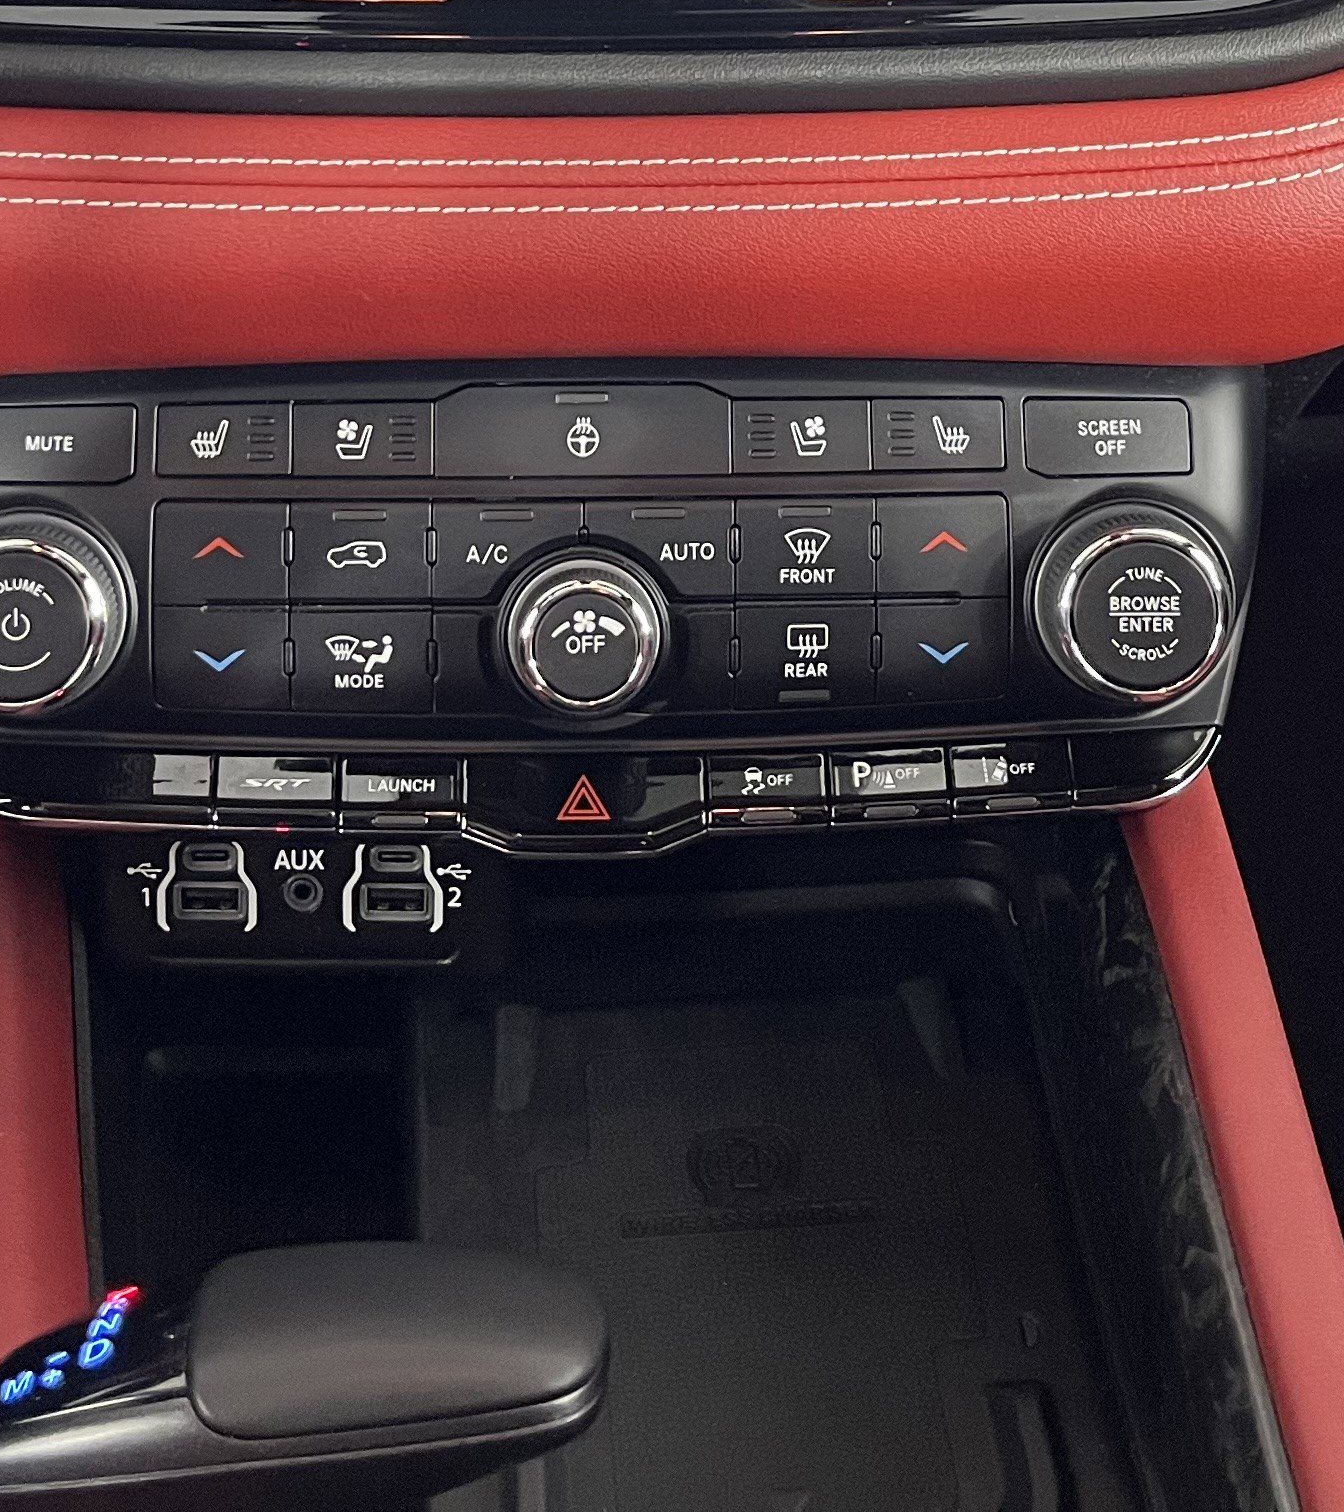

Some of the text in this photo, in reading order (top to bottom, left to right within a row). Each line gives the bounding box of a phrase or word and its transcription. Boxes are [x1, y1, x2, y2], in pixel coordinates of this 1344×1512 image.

[1077, 419, 1142, 436] SCREEN
[24, 435, 74, 452] MUTE
[1094, 440, 1126, 456] OFF
[465, 542, 508, 565] A/C
[659, 542, 715, 561] AUTO
[779, 568, 835, 584] FRONT
[1125, 566, 1165, 582] TUNE
[1109, 596, 1181, 611] BROWSE
[1118, 617, 1174, 632] ENTER
[565, 634, 606, 655] OFF
[1118, 642, 1173, 662] SCROLL
[784, 663, 828, 678] REAR
[334, 673, 385, 689] MODE
[895, 767, 921, 780] OFF
[1009, 762, 1035, 775] OFF
[367, 777, 436, 793] LAUNCH
[766, 773, 794, 786] OFF
[273, 849, 325, 871] AUX
[141, 886, 151, 907] 1
[447, 887, 462, 907] 2
[82, 1338, 113, 1366] D
[2, 1370, 34, 1402] M
